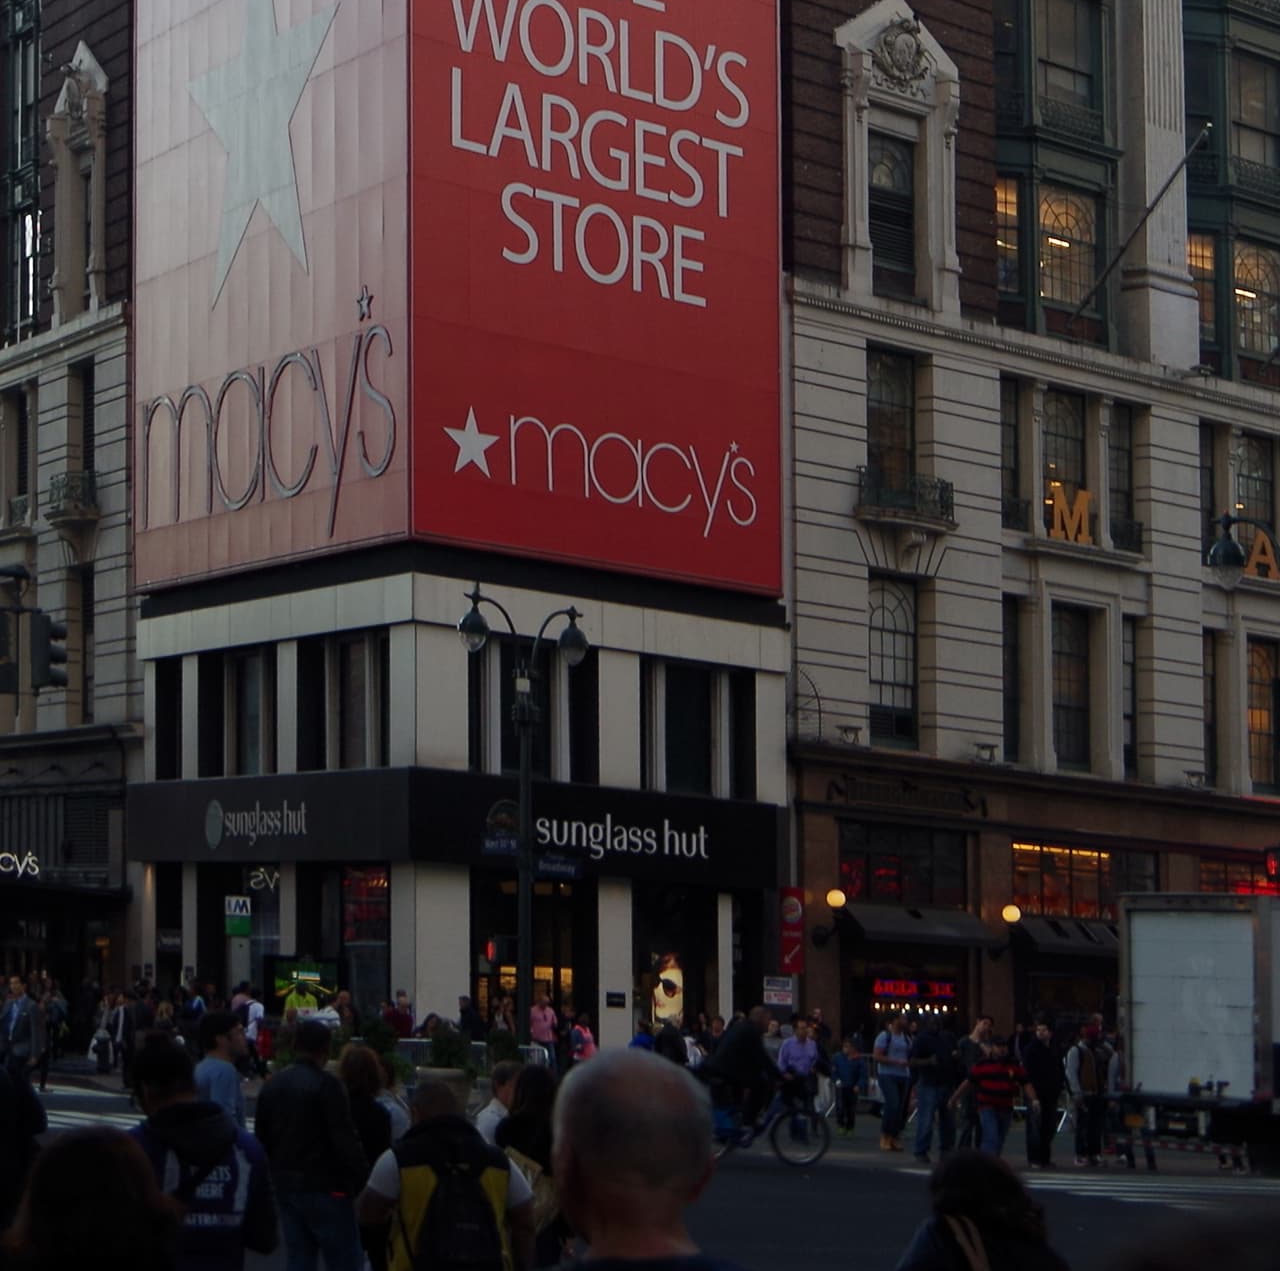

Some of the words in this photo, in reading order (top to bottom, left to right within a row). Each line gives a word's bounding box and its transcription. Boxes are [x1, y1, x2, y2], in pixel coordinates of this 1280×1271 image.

[451, 67, 744, 218] LARGEST
[501, 182, 707, 308] STORE
[224, 799, 281, 846] sunglass
[283, 799, 308, 836] hut
[536, 812, 657, 860] sunglass
[663, 817, 710, 859] hut
